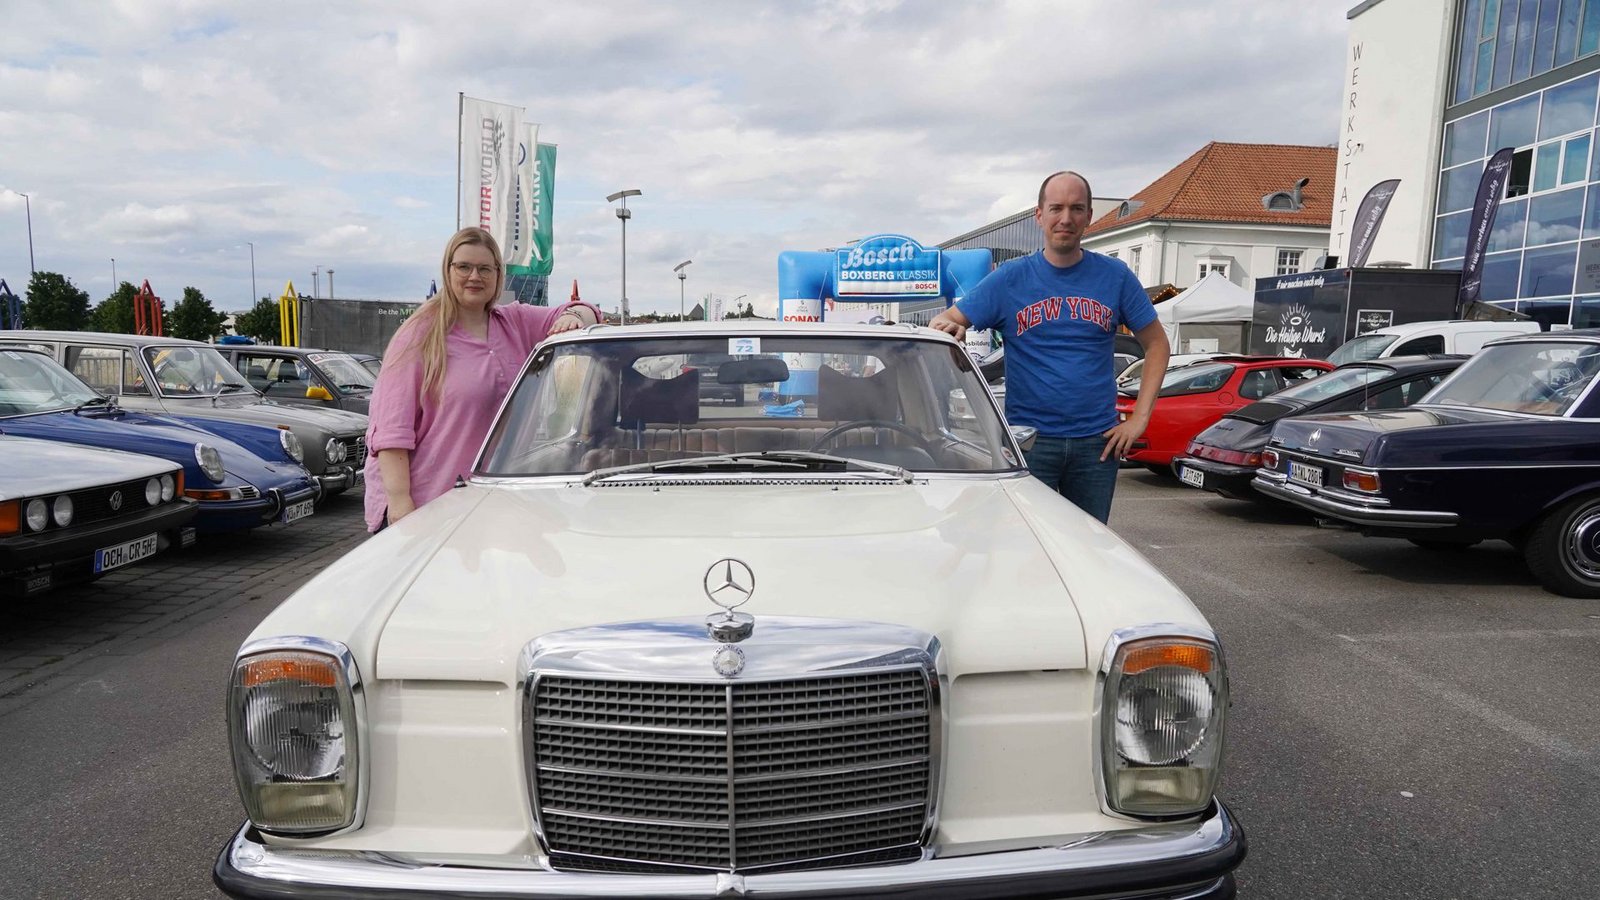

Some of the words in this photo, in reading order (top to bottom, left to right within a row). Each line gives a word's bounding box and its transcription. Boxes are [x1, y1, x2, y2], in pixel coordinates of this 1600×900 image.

[841, 240, 914, 269] Bosch
[842, 270, 895, 280] BOXBERG
[896, 270, 937, 280] KLASSIK
[1016, 296, 1063, 336] NEW
[1065, 296, 1113, 332] YORK
[735, 345, 753, 353] 72
[1265, 326, 1278, 343] Die
[1278, 327, 1302, 347] Heilige
[1301, 326, 1326, 343] Wurst
[104, 547, 123, 568] OCH
[128, 542, 141, 560] CR
[142, 538, 153, 556] 5H
